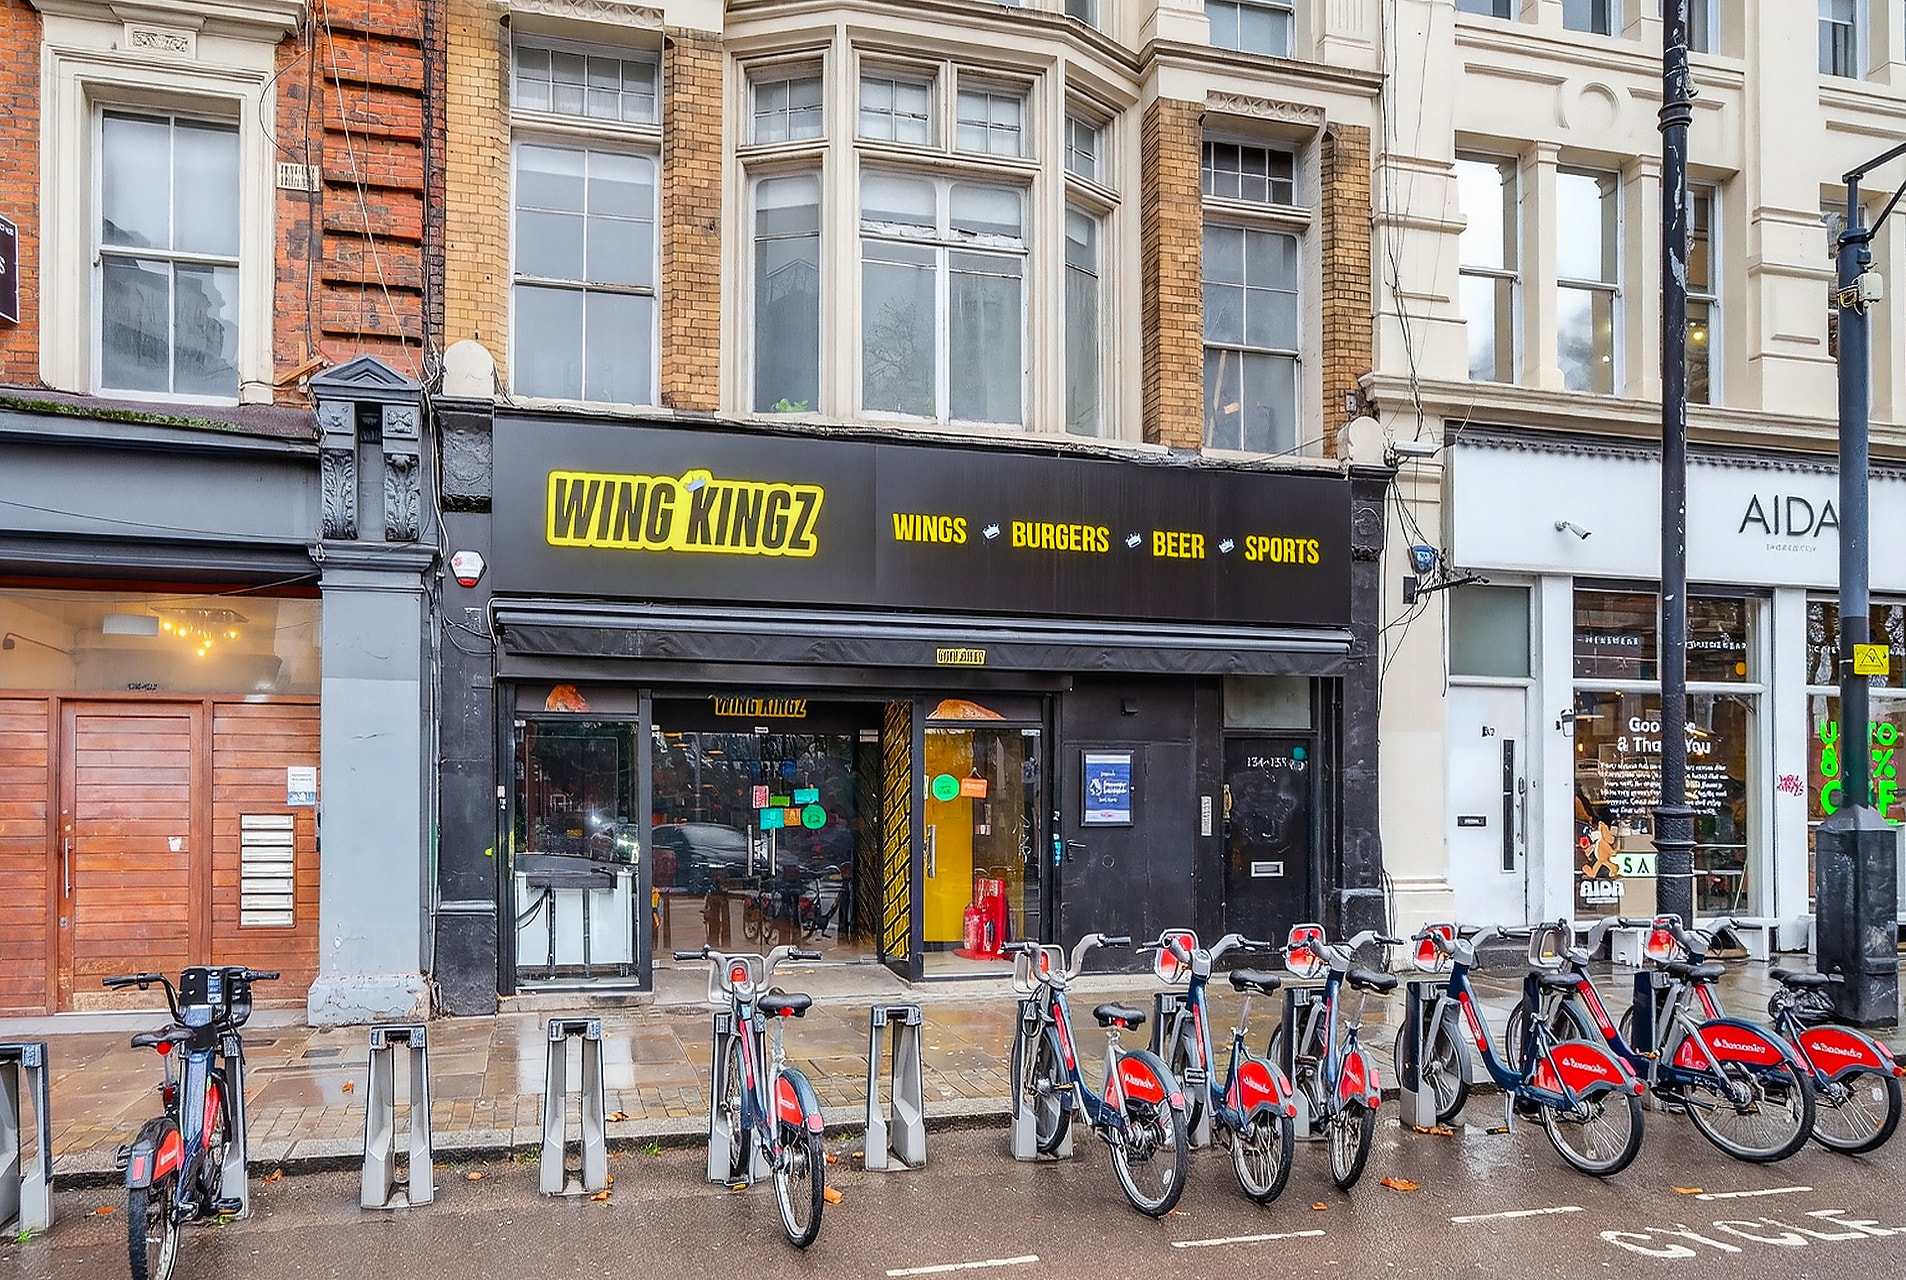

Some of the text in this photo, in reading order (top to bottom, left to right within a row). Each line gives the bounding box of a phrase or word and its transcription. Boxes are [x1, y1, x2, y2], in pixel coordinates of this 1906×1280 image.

[553, 477, 817, 550] WING KINGZ
[892, 512, 1321, 564] WINGS BURGERS BEER SPORTS
[1738, 494, 1840, 538] AIDA
[1599, 1208, 1906, 1258] CYCLE
